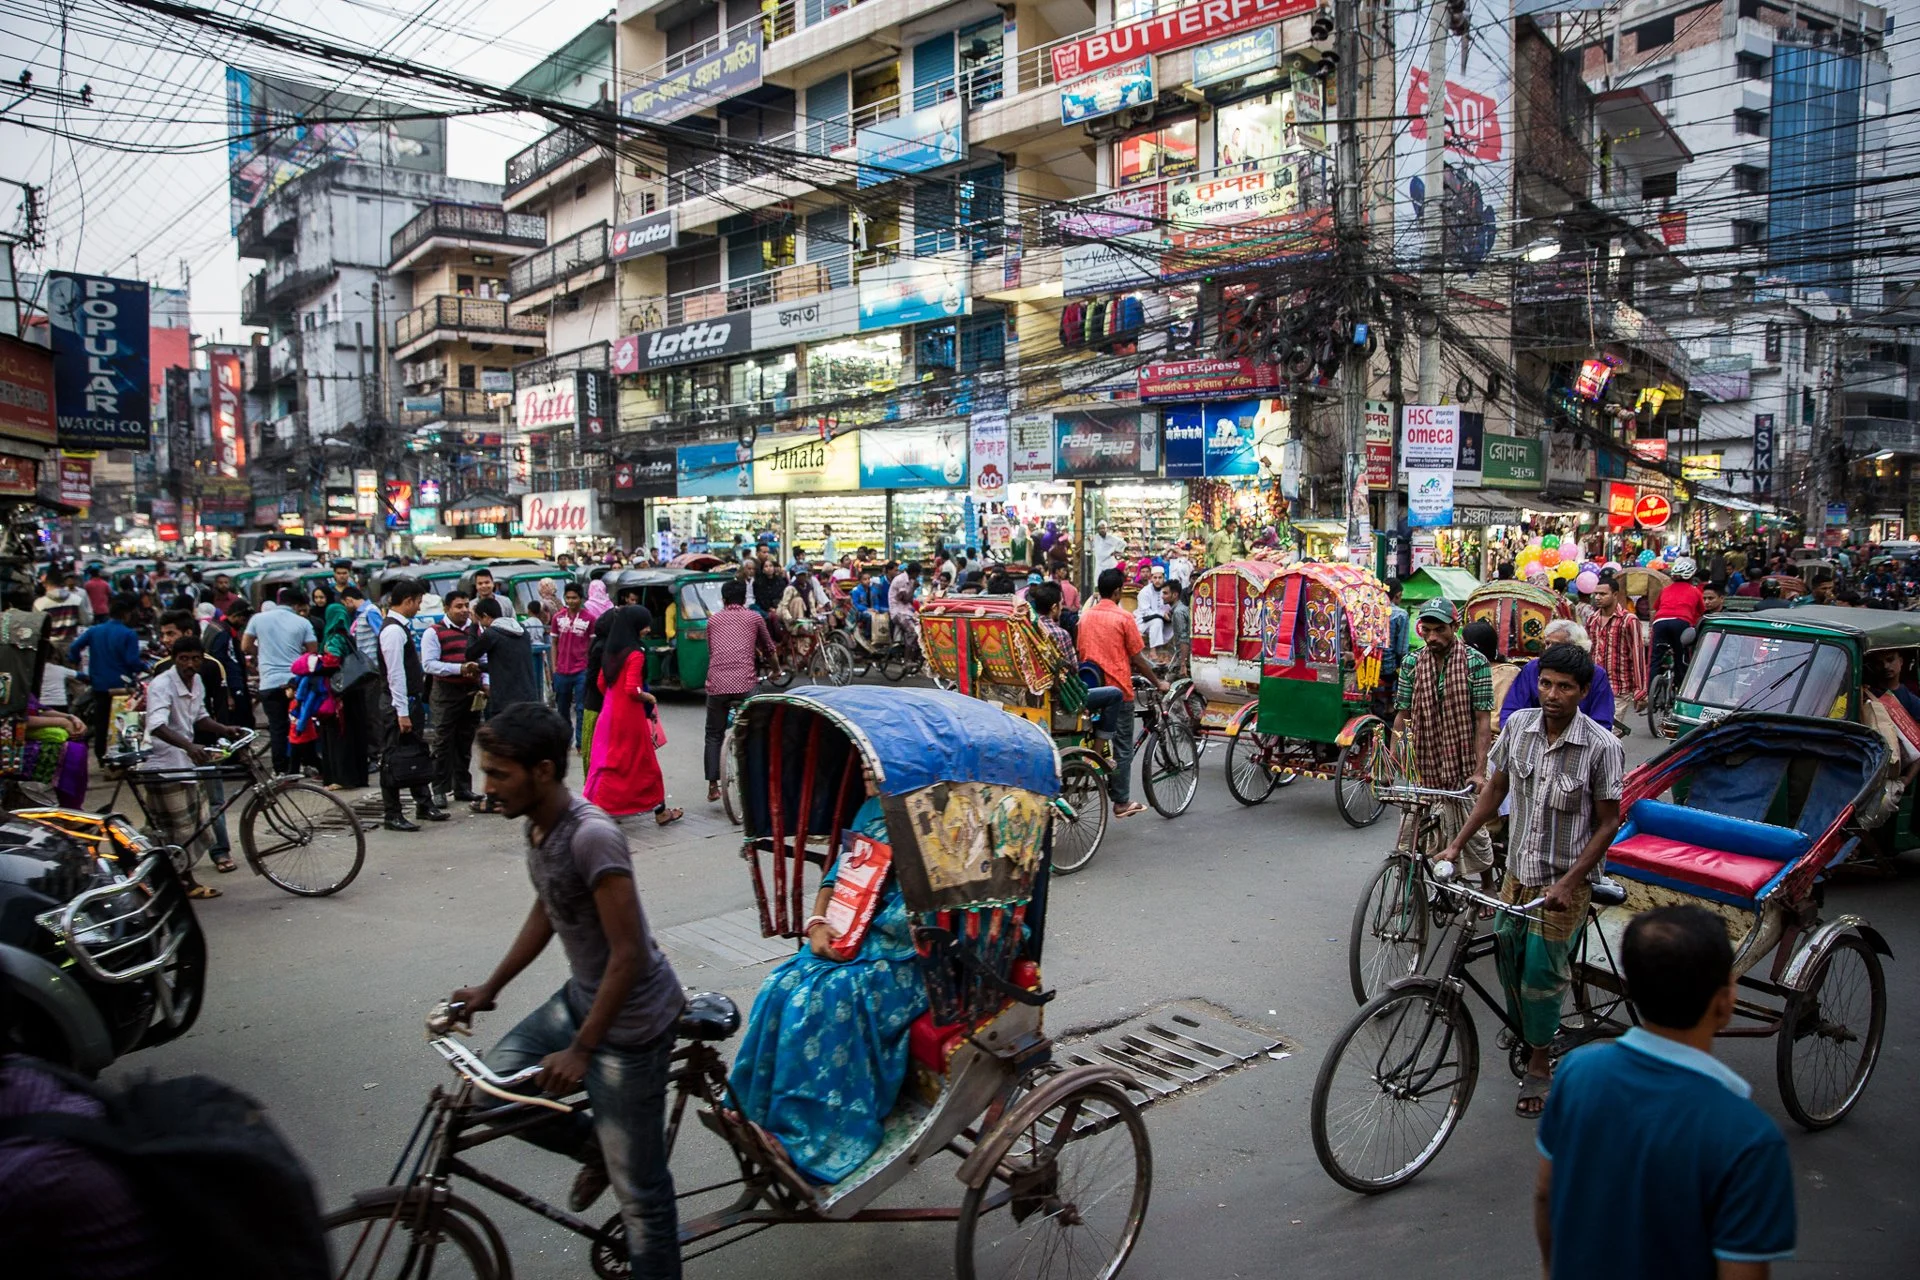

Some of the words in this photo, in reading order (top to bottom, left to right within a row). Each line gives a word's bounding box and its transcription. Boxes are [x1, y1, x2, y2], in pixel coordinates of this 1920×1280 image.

[83, 279, 120, 414] POPULAR
[649, 353, 687, 367] ITALIAN
[1157, 363, 1185, 377] Fast
[1188, 360, 1242, 374] Express
[58, 415, 115, 433] WATCH
[119, 420, 147, 435] CO.
[1408, 408, 1434, 425] HSC
[1408, 428, 1453, 444] omeca
[770, 446, 825, 472] Janata
[1489, 442, 1528, 463] রোমান
[1756, 431, 1770, 493] SKY
[526, 498, 588, 531] Bata
